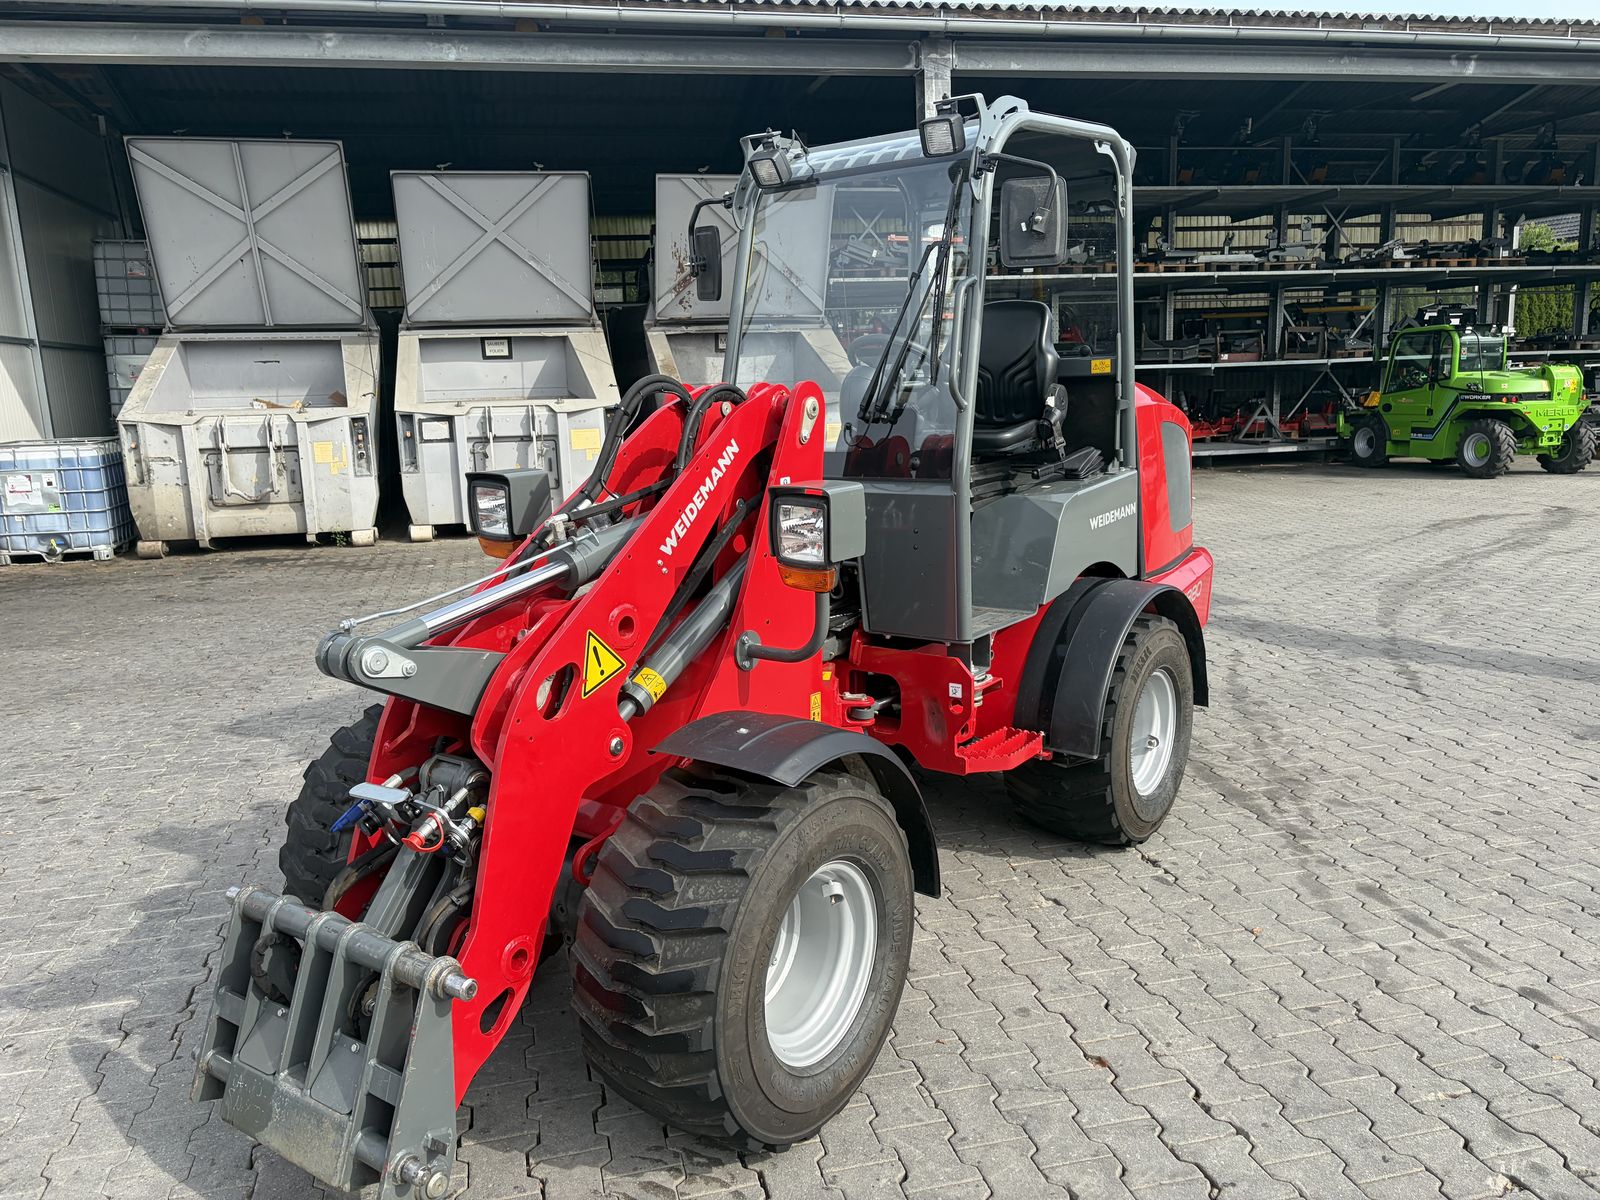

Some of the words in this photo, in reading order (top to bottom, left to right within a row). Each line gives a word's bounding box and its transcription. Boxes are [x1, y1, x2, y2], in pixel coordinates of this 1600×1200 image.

[1536, 408, 1575, 418] MERLO
[659, 438, 741, 556] WEIDEMANN
[1089, 502, 1137, 531] WEIDEMANN
